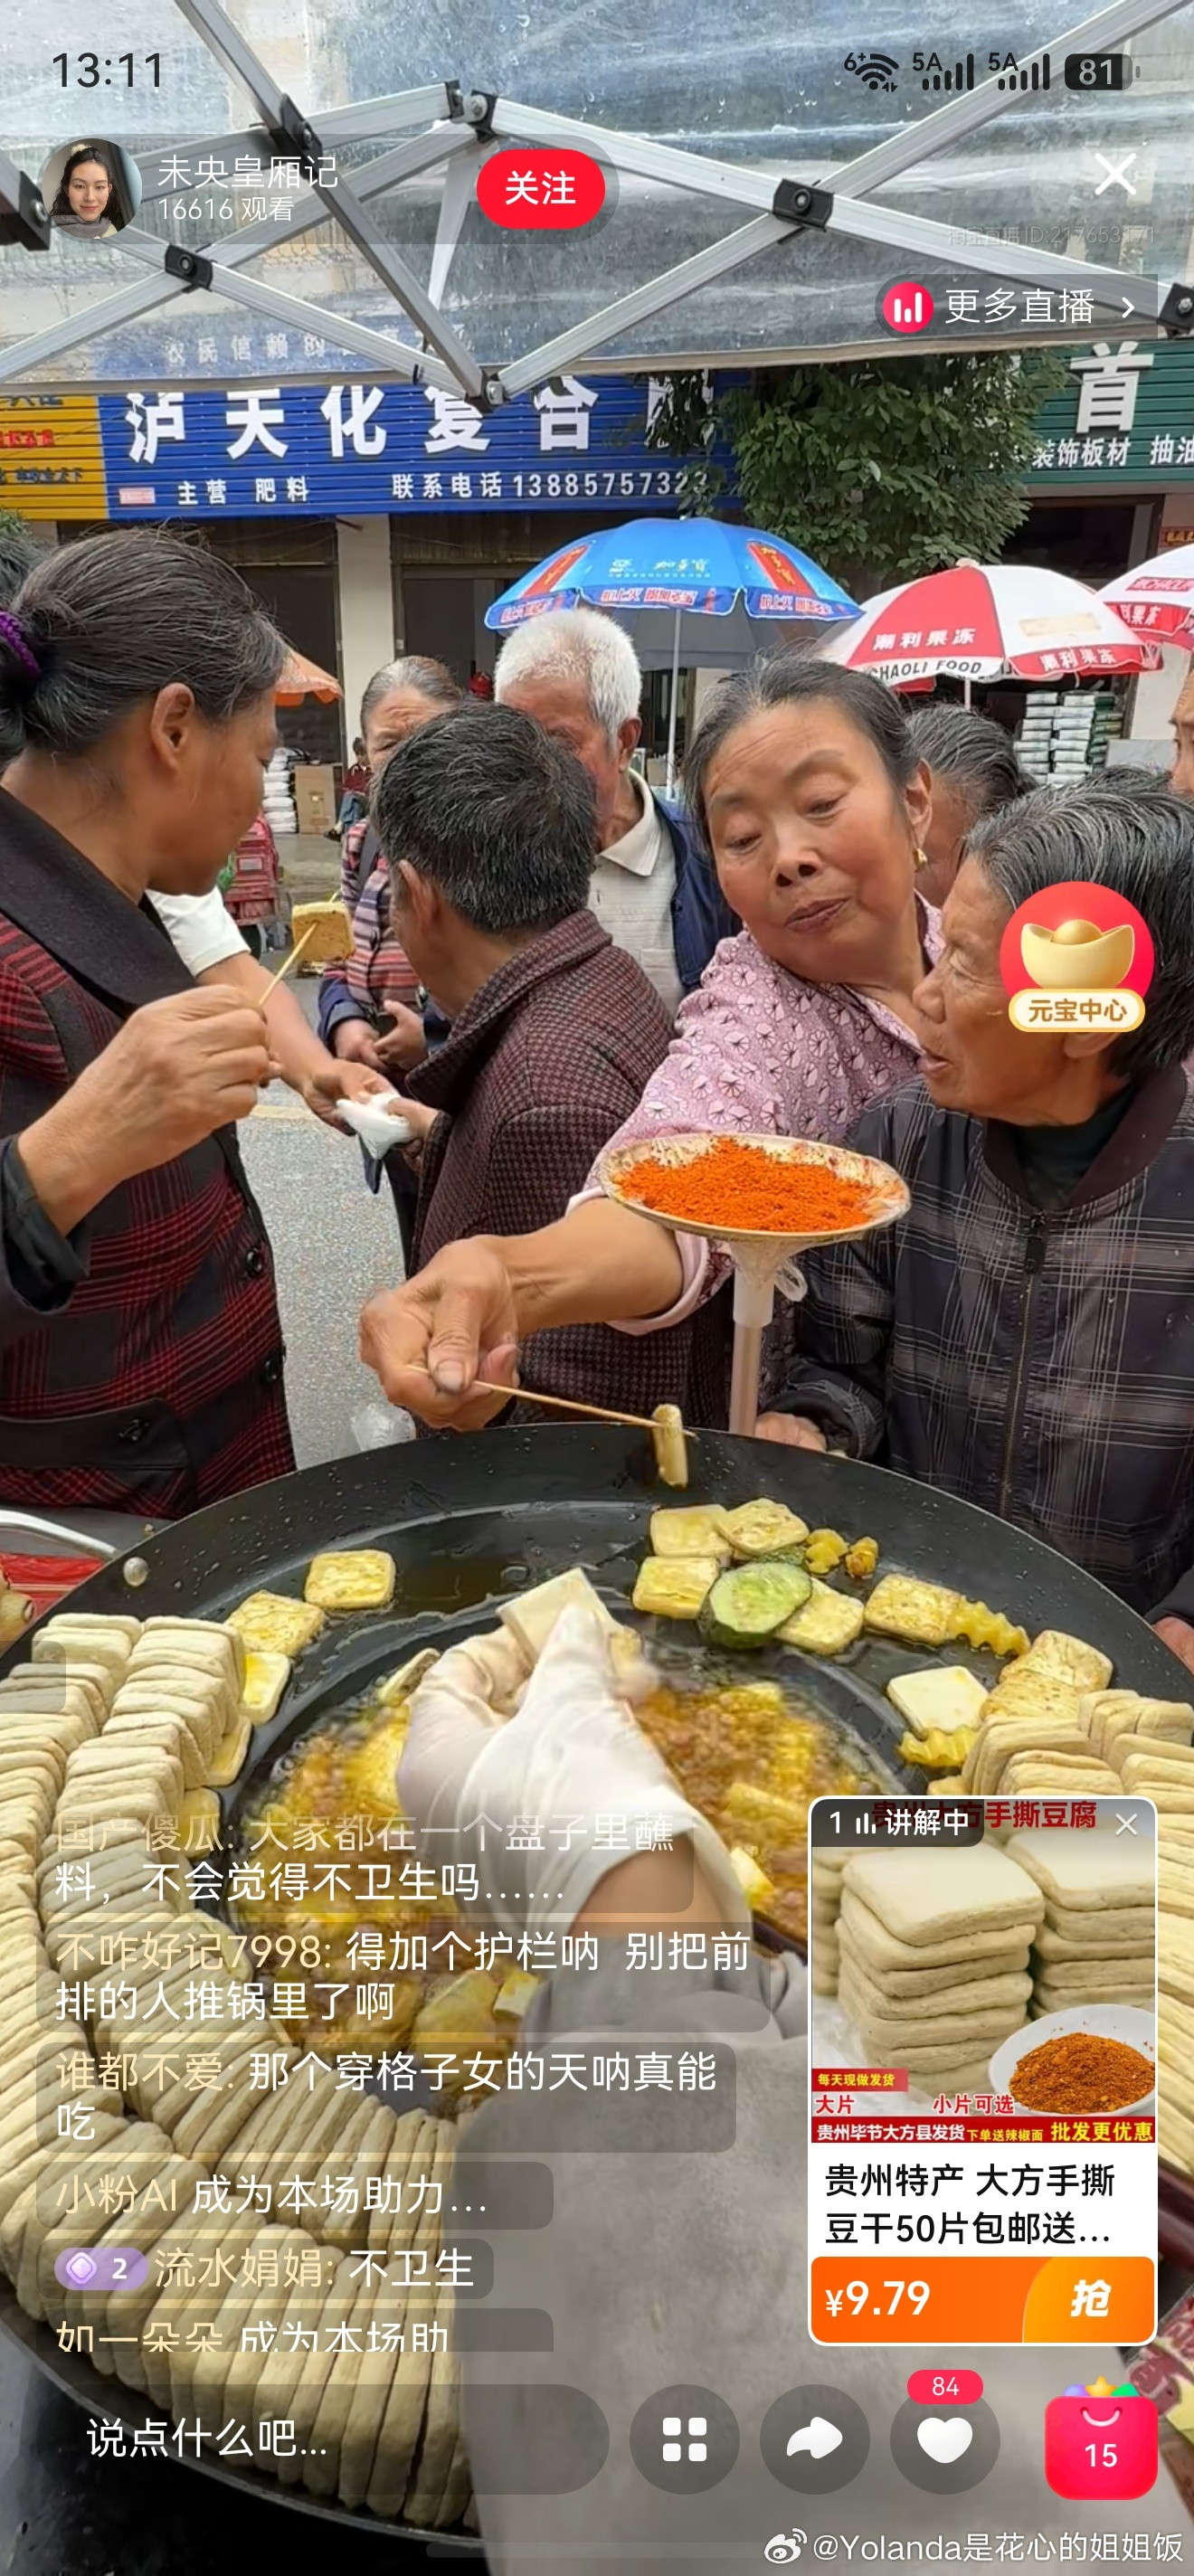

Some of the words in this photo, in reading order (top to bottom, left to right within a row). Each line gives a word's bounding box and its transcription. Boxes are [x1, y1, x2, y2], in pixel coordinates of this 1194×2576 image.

[1069, 341, 1154, 433] 首
[124, 365, 716, 465] 泸天化复合
[1032, 438, 1130, 469] 装饰板材
[177, 478, 227, 507] 主营
[255, 476, 310, 505] 肥料
[872, 627, 976, 651] 潮利果冻
[935, 658, 983, 675] FOOD
